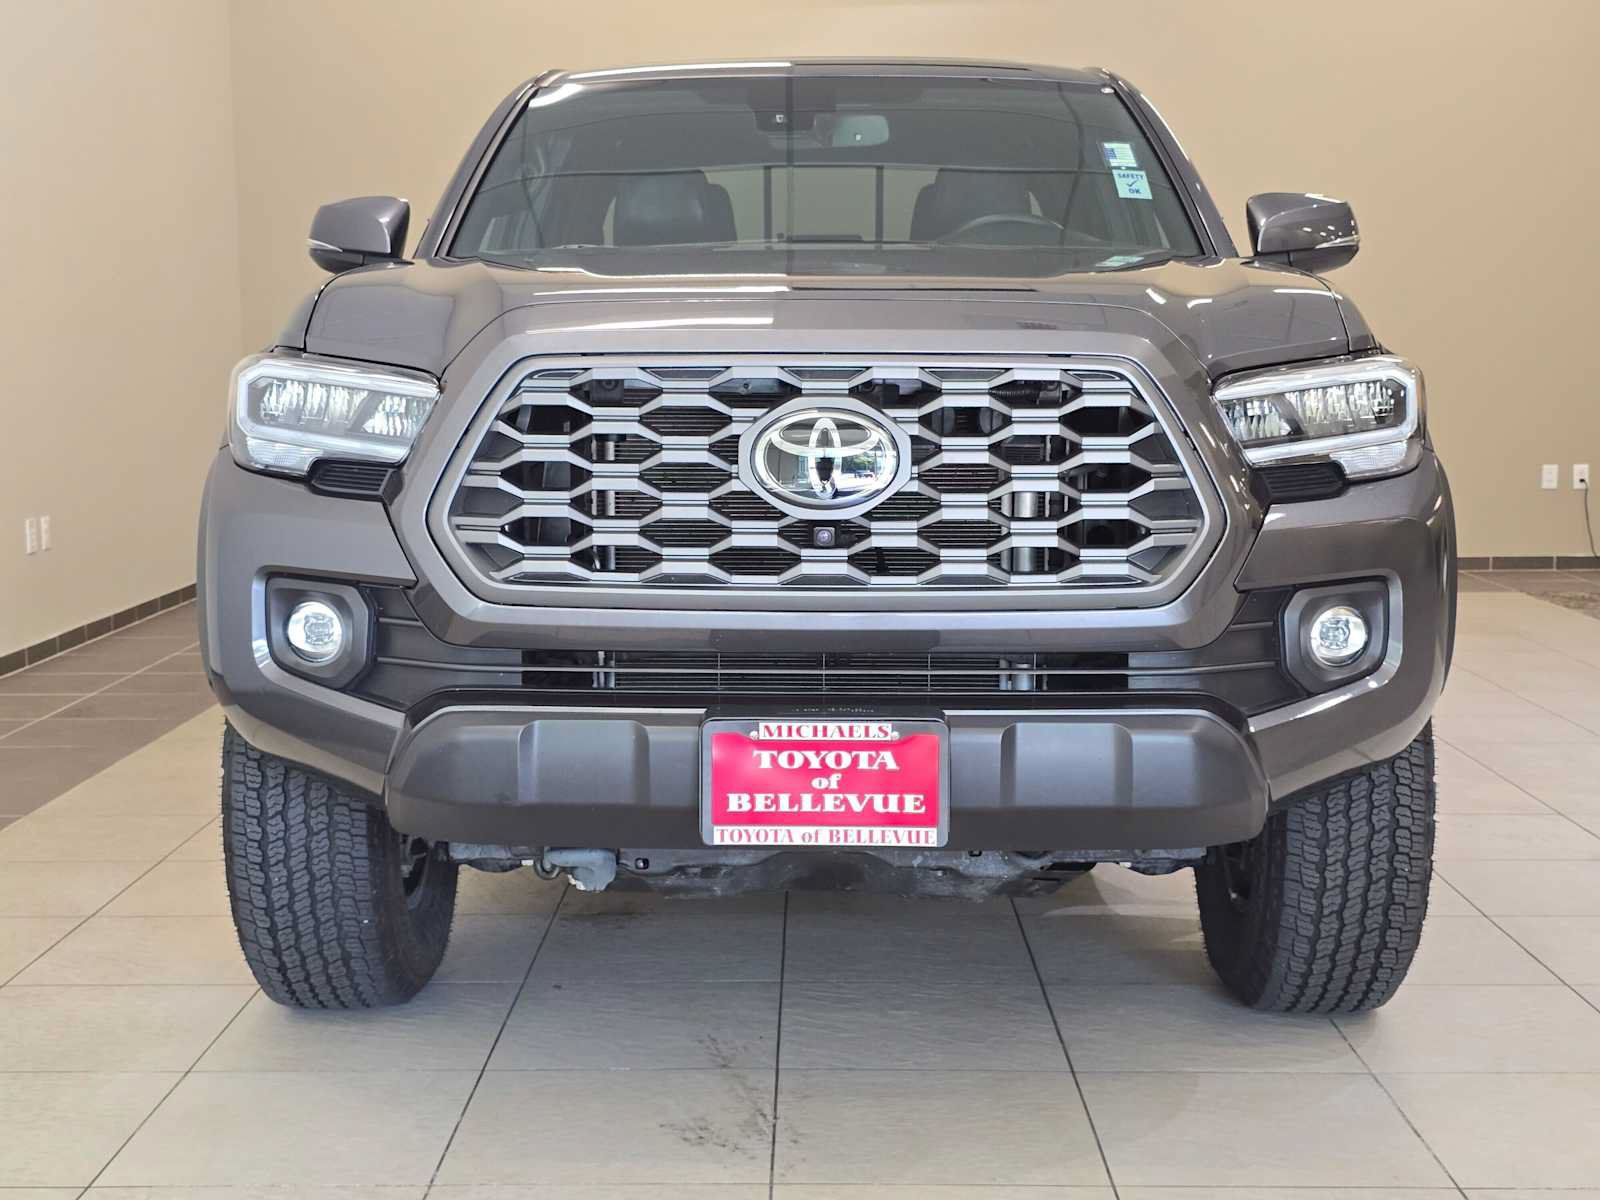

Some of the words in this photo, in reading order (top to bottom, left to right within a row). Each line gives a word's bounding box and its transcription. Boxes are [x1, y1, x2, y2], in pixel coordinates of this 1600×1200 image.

[762, 724, 890, 738] MICHAELS
[752, 750, 900, 770] TOYOTA
[811, 773, 842, 789] of
[726, 793, 926, 813] BELLEVUE
[716, 829, 795, 844] TOYOTA
[801, 829, 820, 844] of
[828, 829, 937, 845] BELLEVUE
